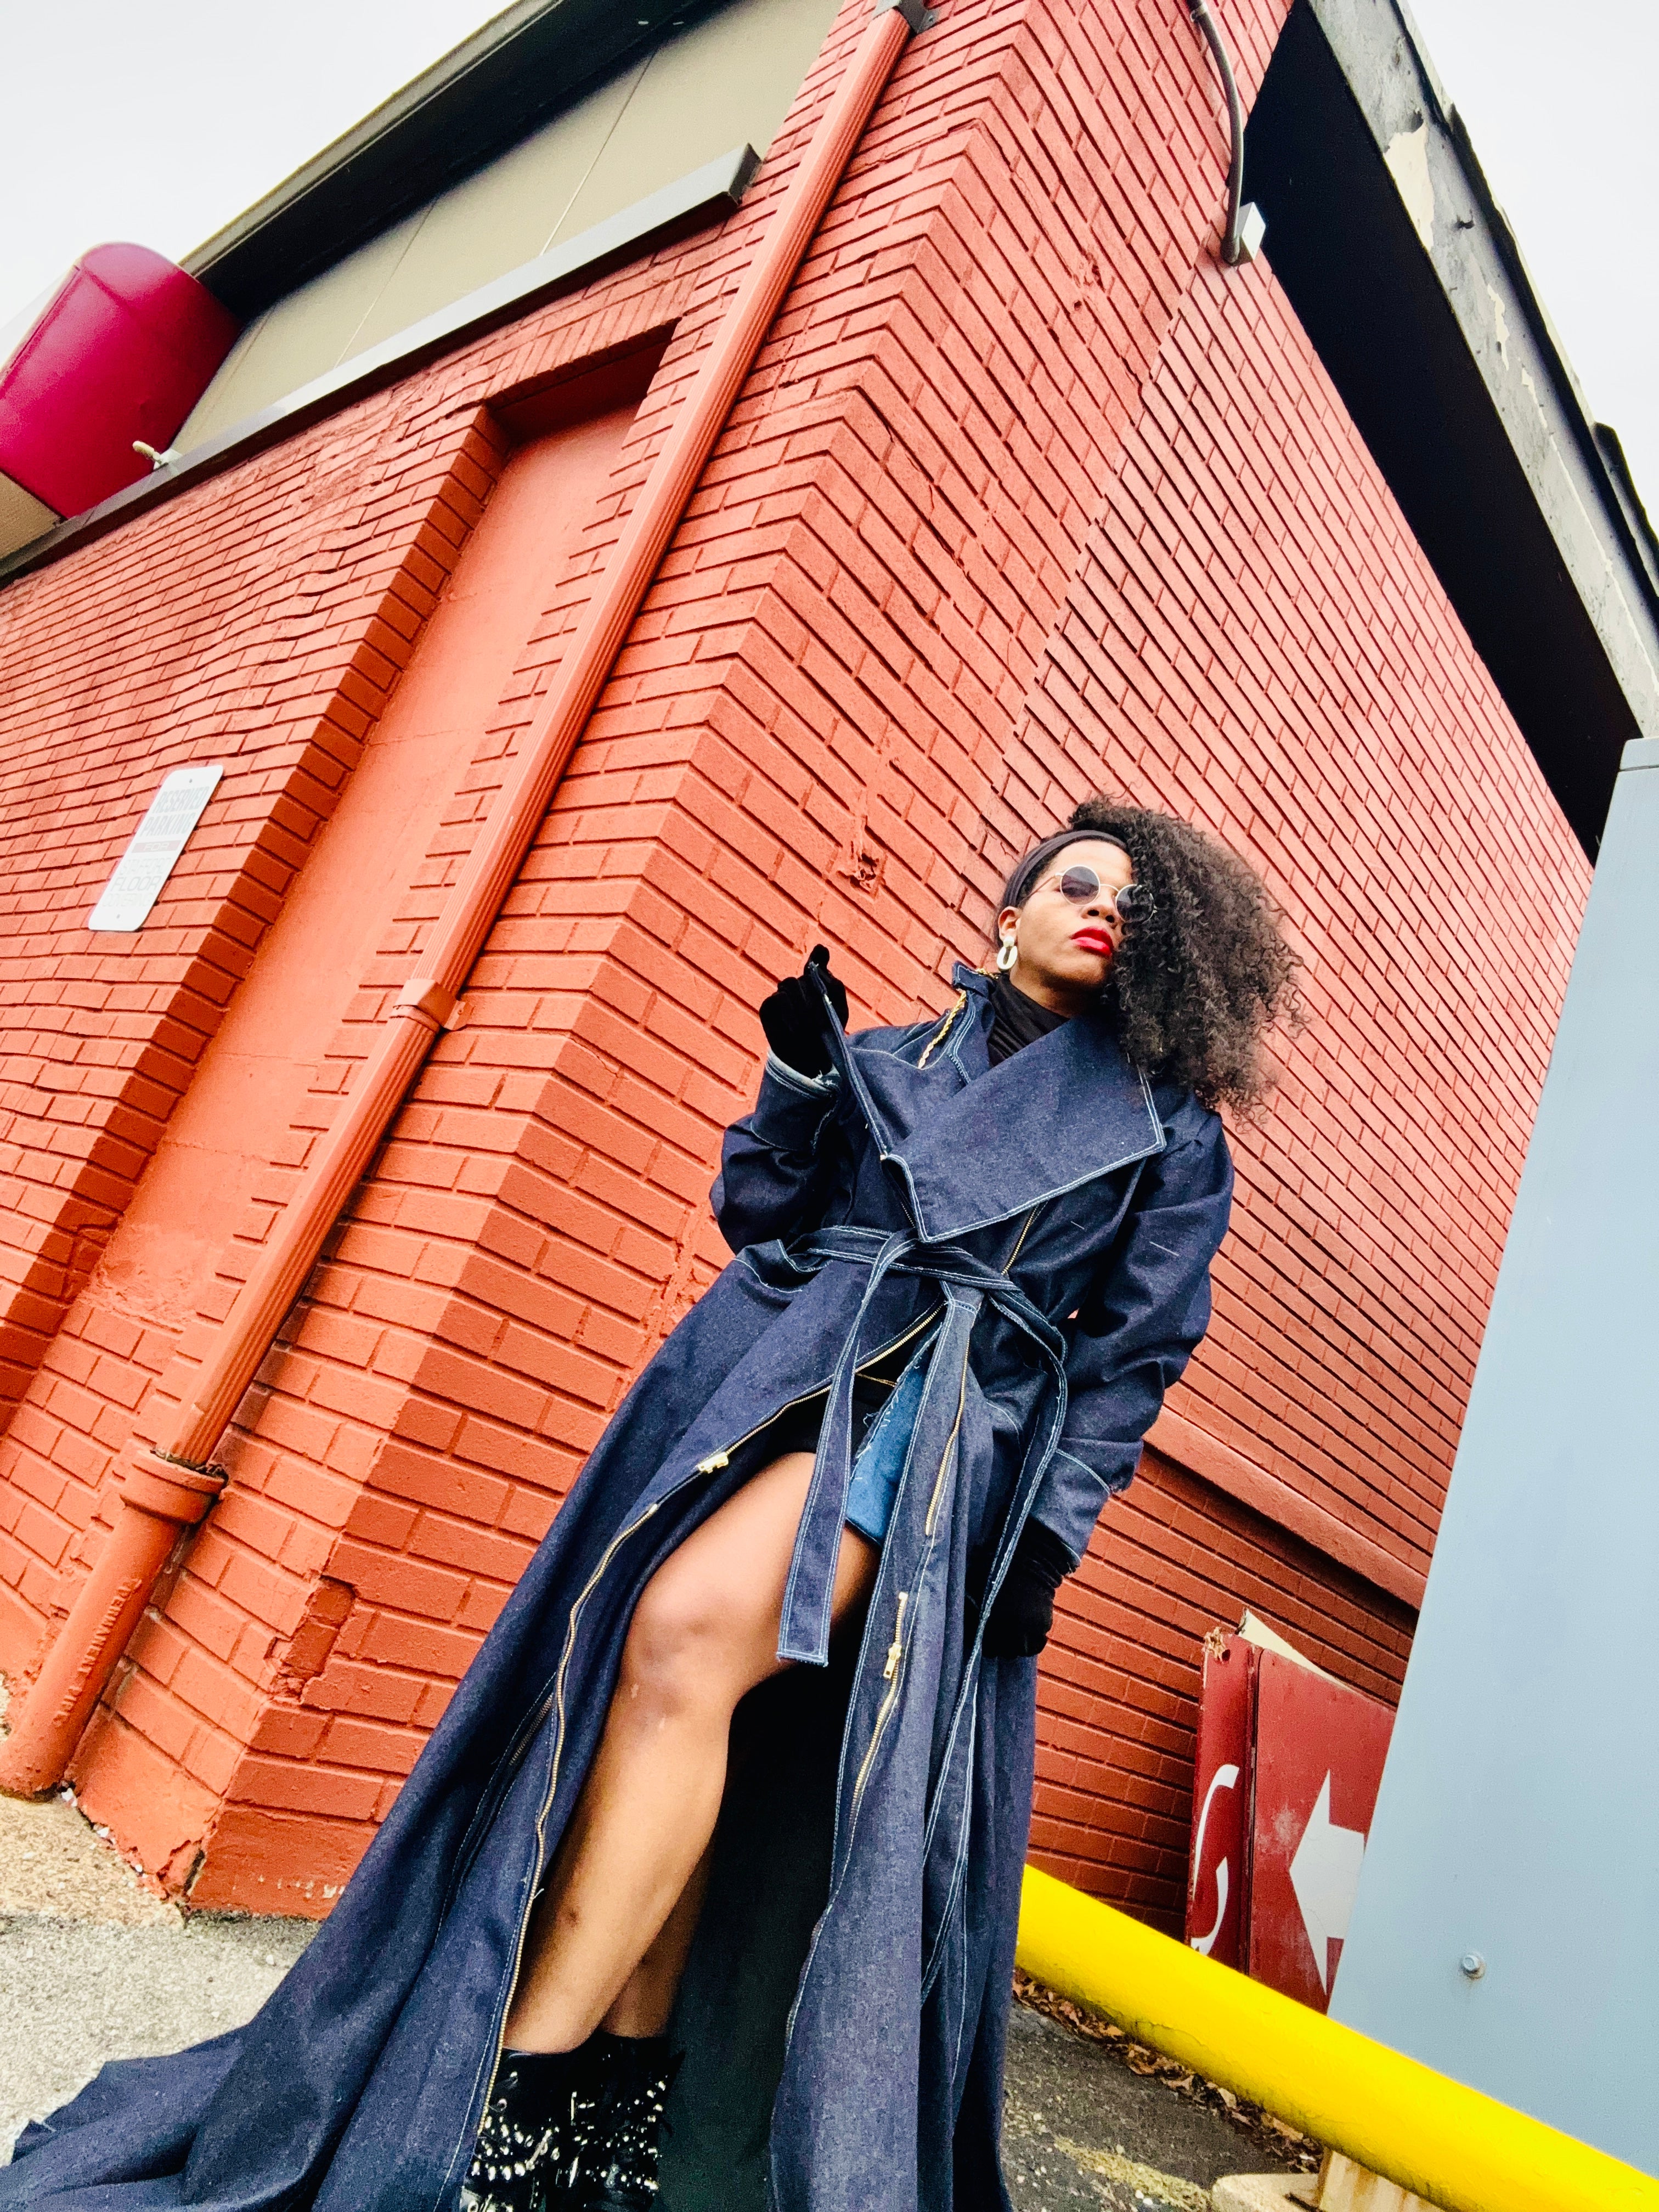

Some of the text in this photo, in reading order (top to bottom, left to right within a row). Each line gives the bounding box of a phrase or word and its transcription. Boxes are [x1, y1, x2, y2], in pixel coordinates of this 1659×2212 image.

[152, 786, 210, 814] RESERVED
[139, 812, 196, 837] PARKING
[143, 842, 170, 851] FOR
[110, 876, 162, 891] FLOOR
